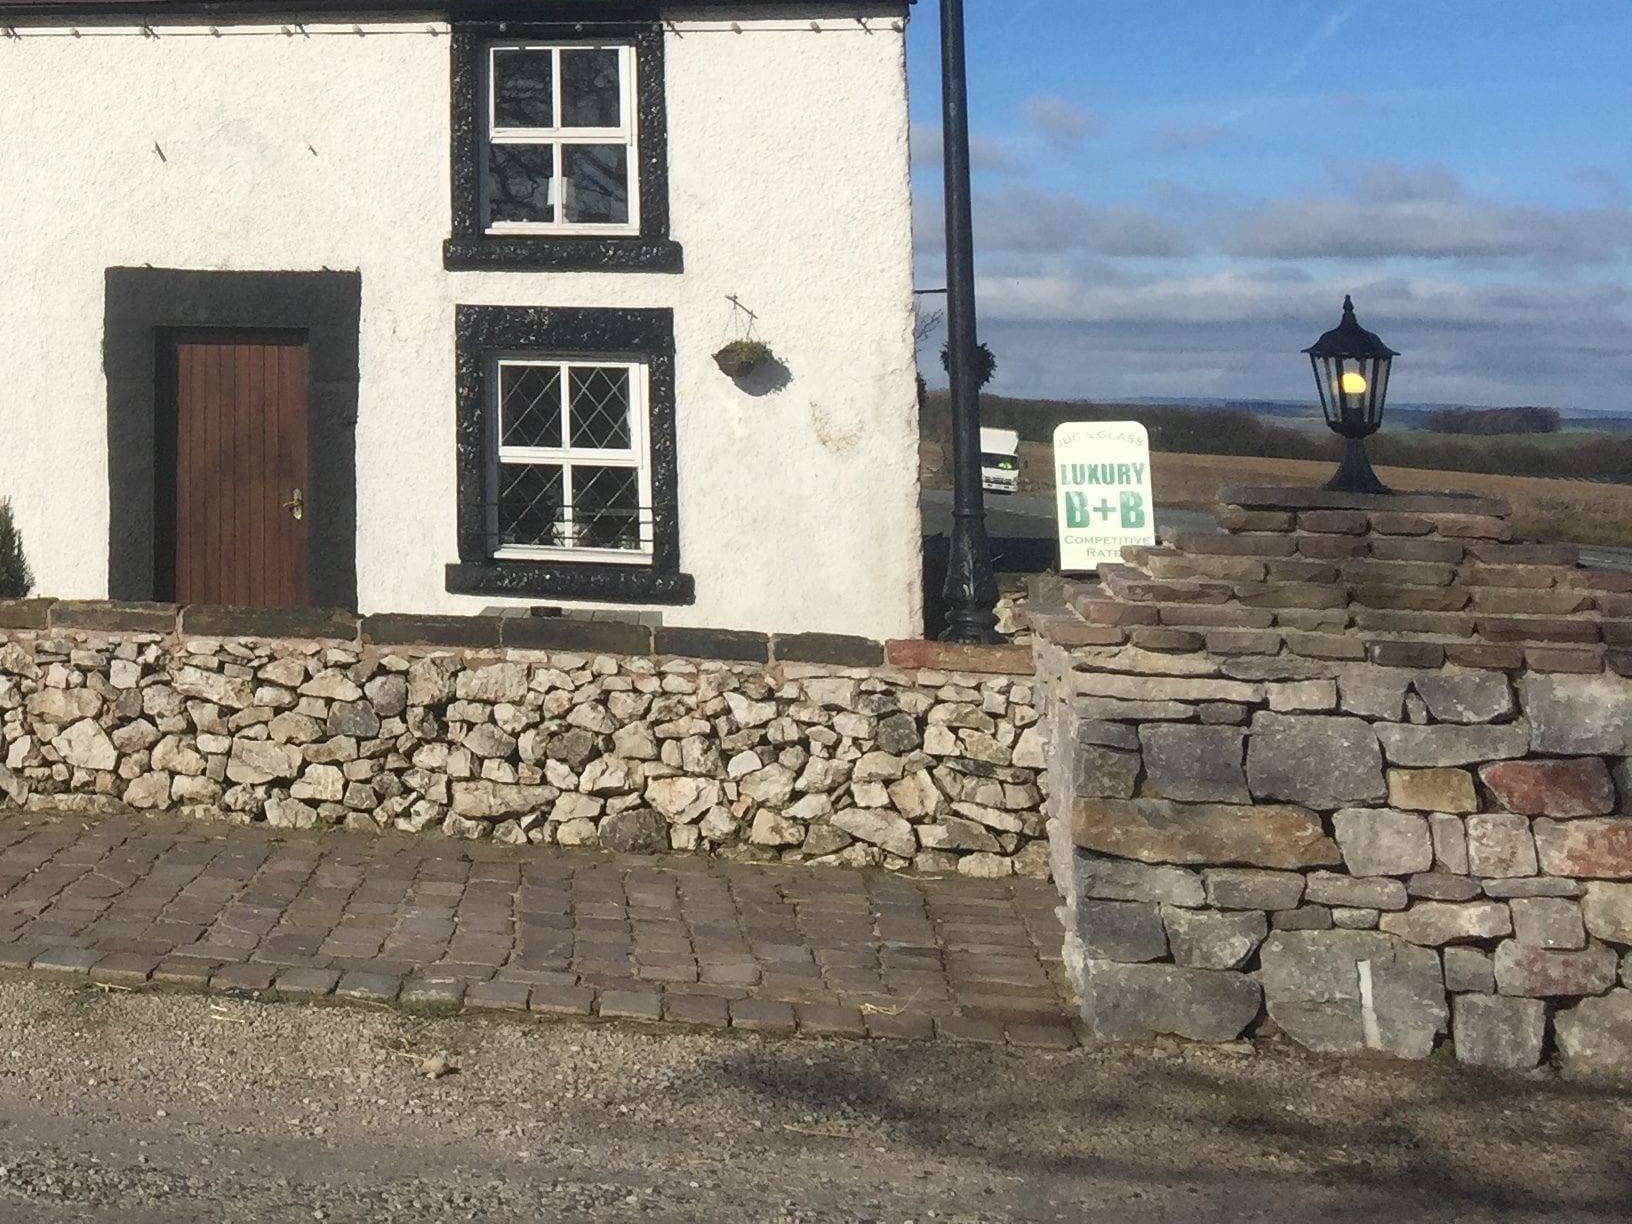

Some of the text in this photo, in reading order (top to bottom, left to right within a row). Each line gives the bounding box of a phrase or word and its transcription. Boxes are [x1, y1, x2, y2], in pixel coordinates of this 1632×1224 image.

[1057, 432, 1081, 448] JUG
[1097, 430, 1144, 447] GLASS
[1060, 463, 1145, 485] LUXURY
[1065, 490, 1146, 529] B+B
[1064, 535, 1150, 545] COMPETITIVE
[1086, 548, 1121, 558] RATE
